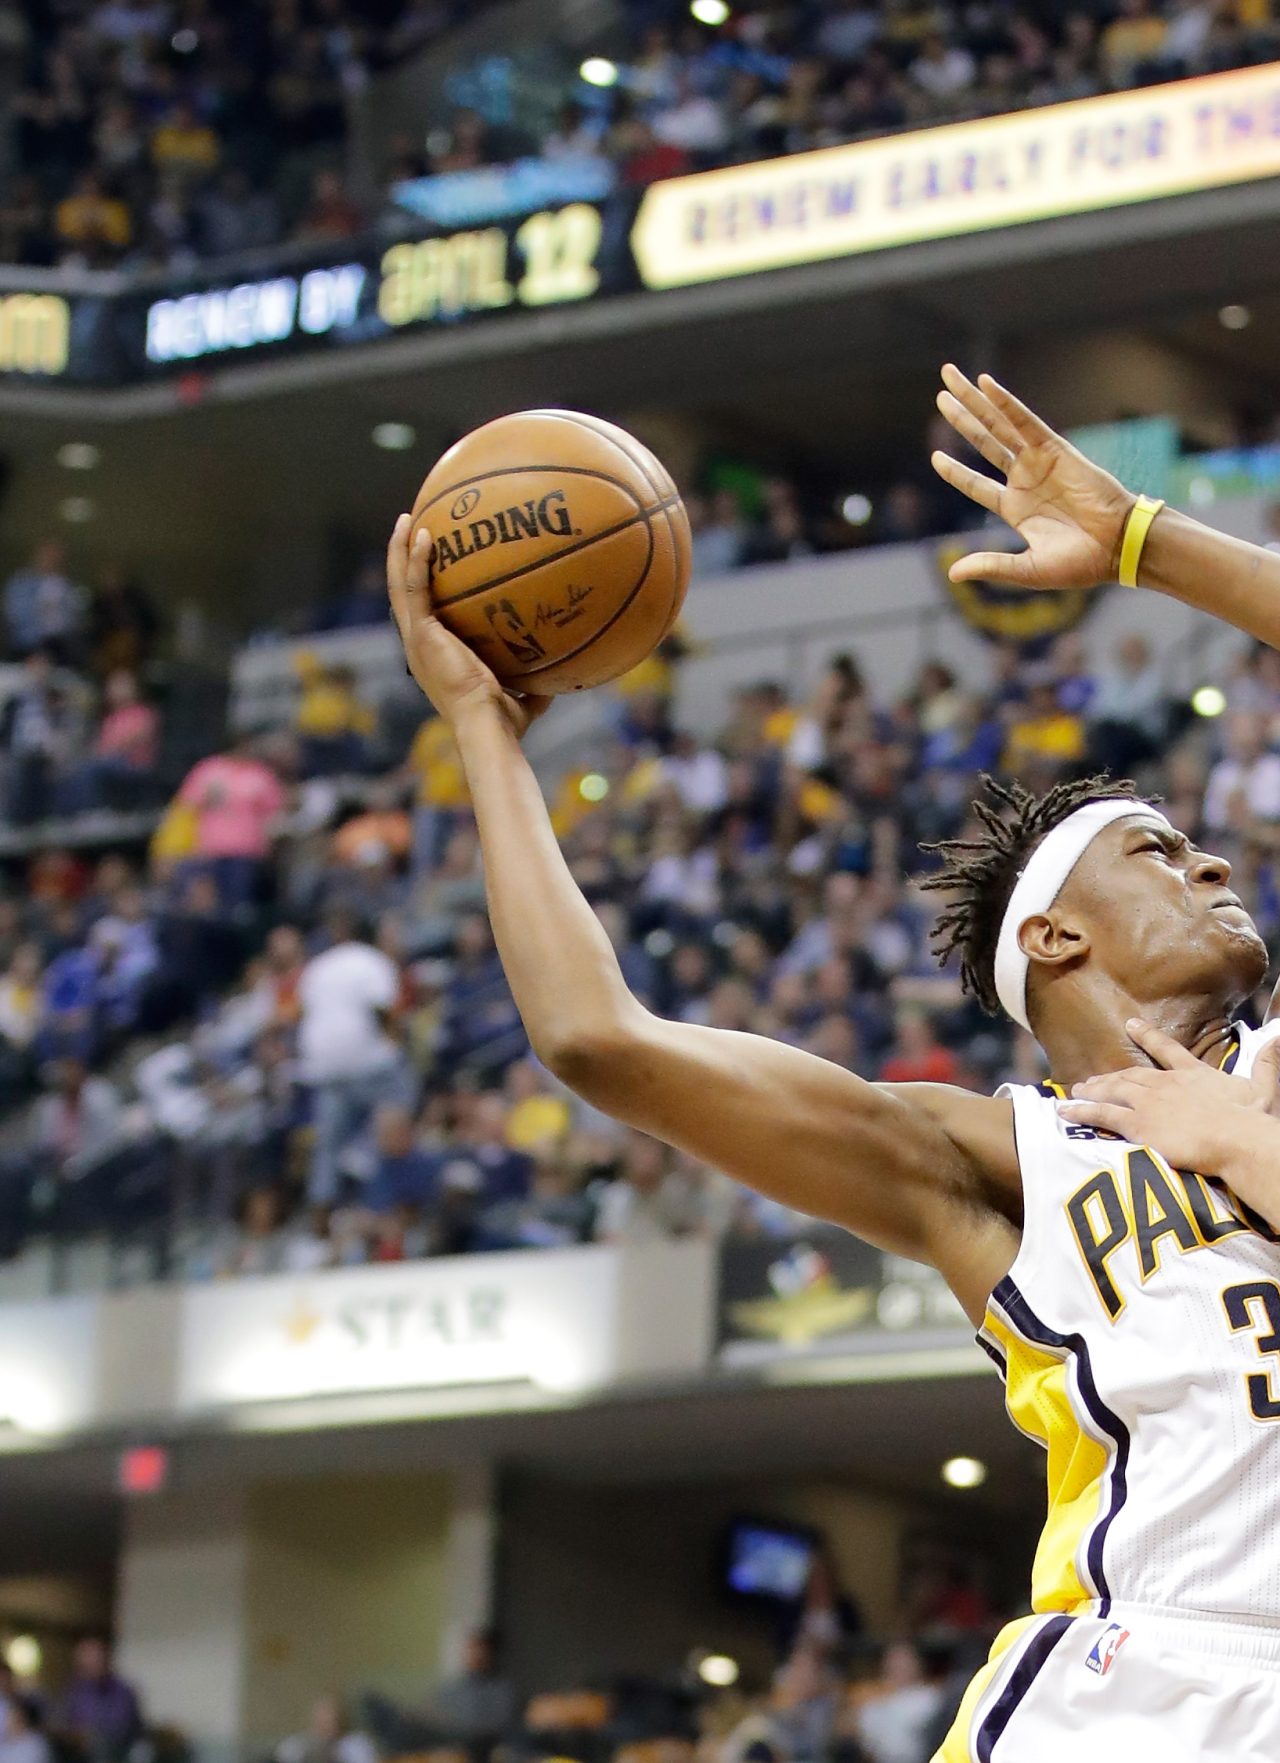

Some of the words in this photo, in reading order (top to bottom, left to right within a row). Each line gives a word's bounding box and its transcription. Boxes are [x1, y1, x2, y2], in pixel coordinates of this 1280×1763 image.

[684, 174, 860, 246] RENEW
[886, 138, 1042, 212] EARLY
[1069, 114, 1166, 168] FOR
[147, 276, 297, 363] RENEW
[300, 262, 366, 334] BY
[515, 203, 602, 306] 12
[429, 489, 573, 573] ALDING
[337, 1284, 508, 1350] STAR
